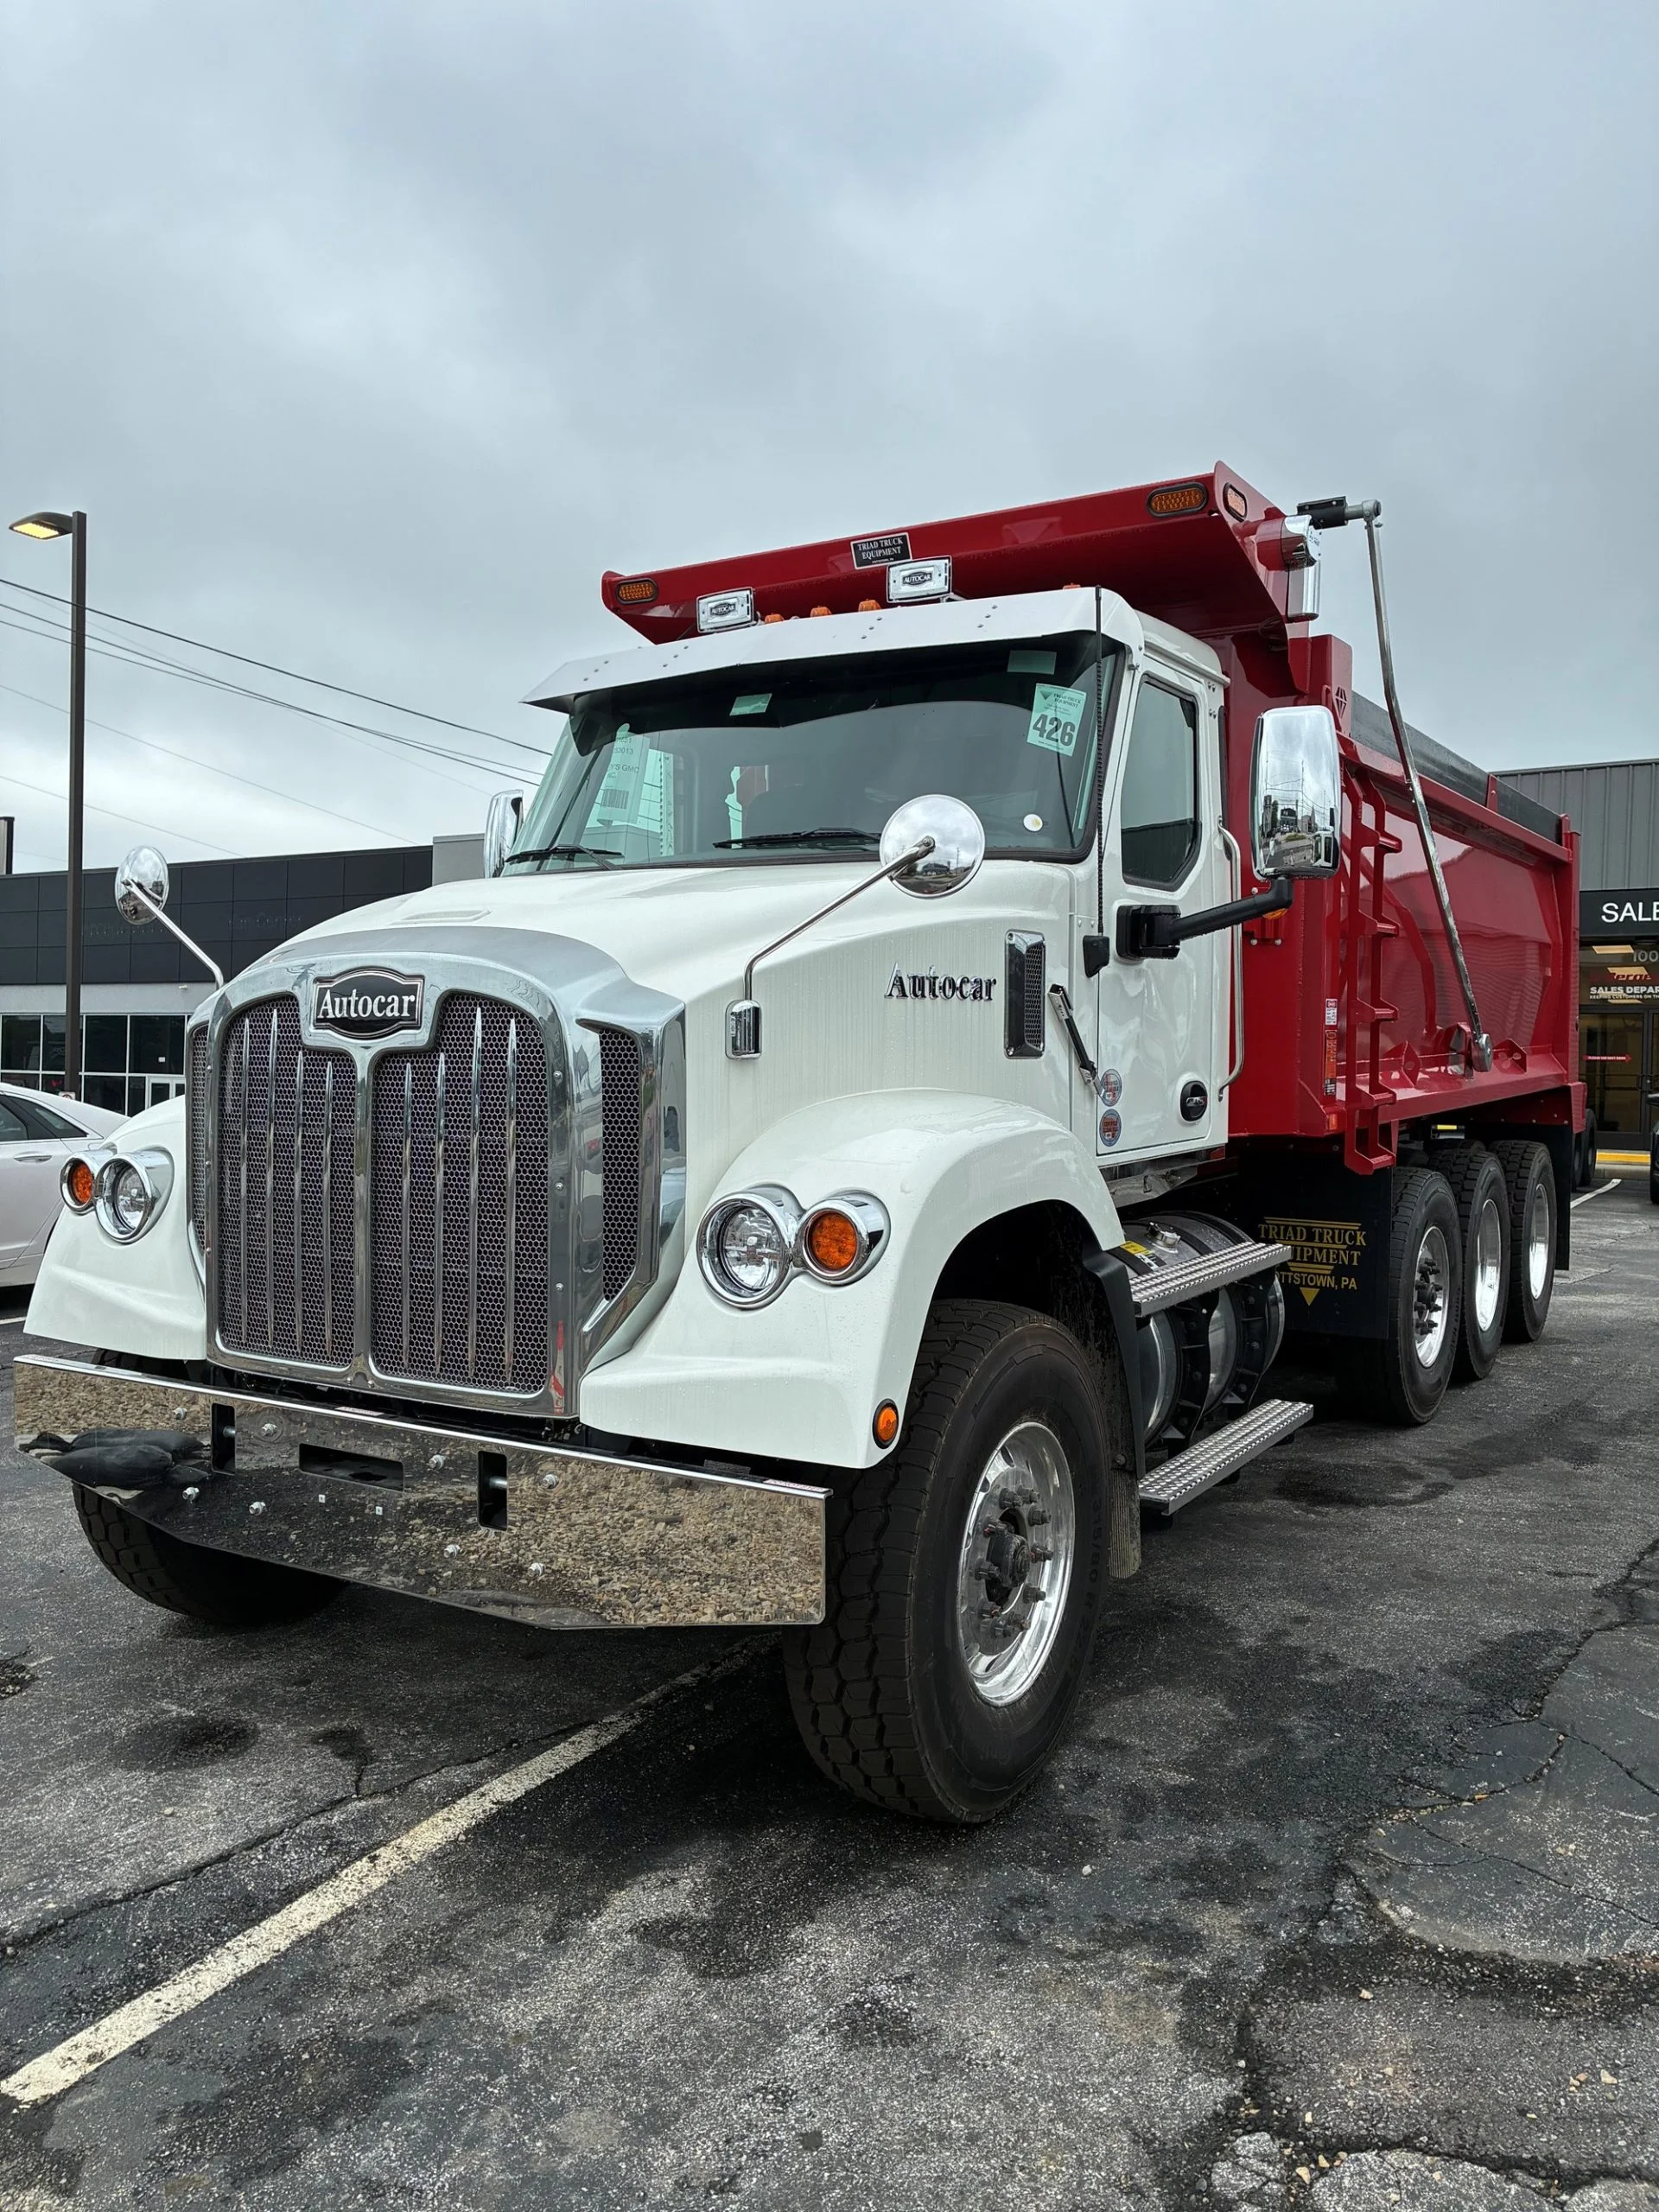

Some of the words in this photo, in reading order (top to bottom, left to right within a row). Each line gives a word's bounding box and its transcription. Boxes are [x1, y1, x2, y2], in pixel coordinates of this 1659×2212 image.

[857, 541, 879, 551] TRIAD
[880, 537, 904, 546] TRUCK
[861, 546, 902, 560] EQUIPMENT
[903, 574, 931, 584] AUTOCAR
[711, 605, 735, 614] AUTOCAR
[1032, 713, 1076, 747] 426
[621, 764, 640, 774] GMC
[884, 962, 997, 1001] Autocar
[316, 988, 416, 1019] Autocar
[1258, 1224, 1307, 1241] TRIAD
[1312, 1228, 1367, 1246] TRUCK
[1340, 1276, 1357, 1290] PA
